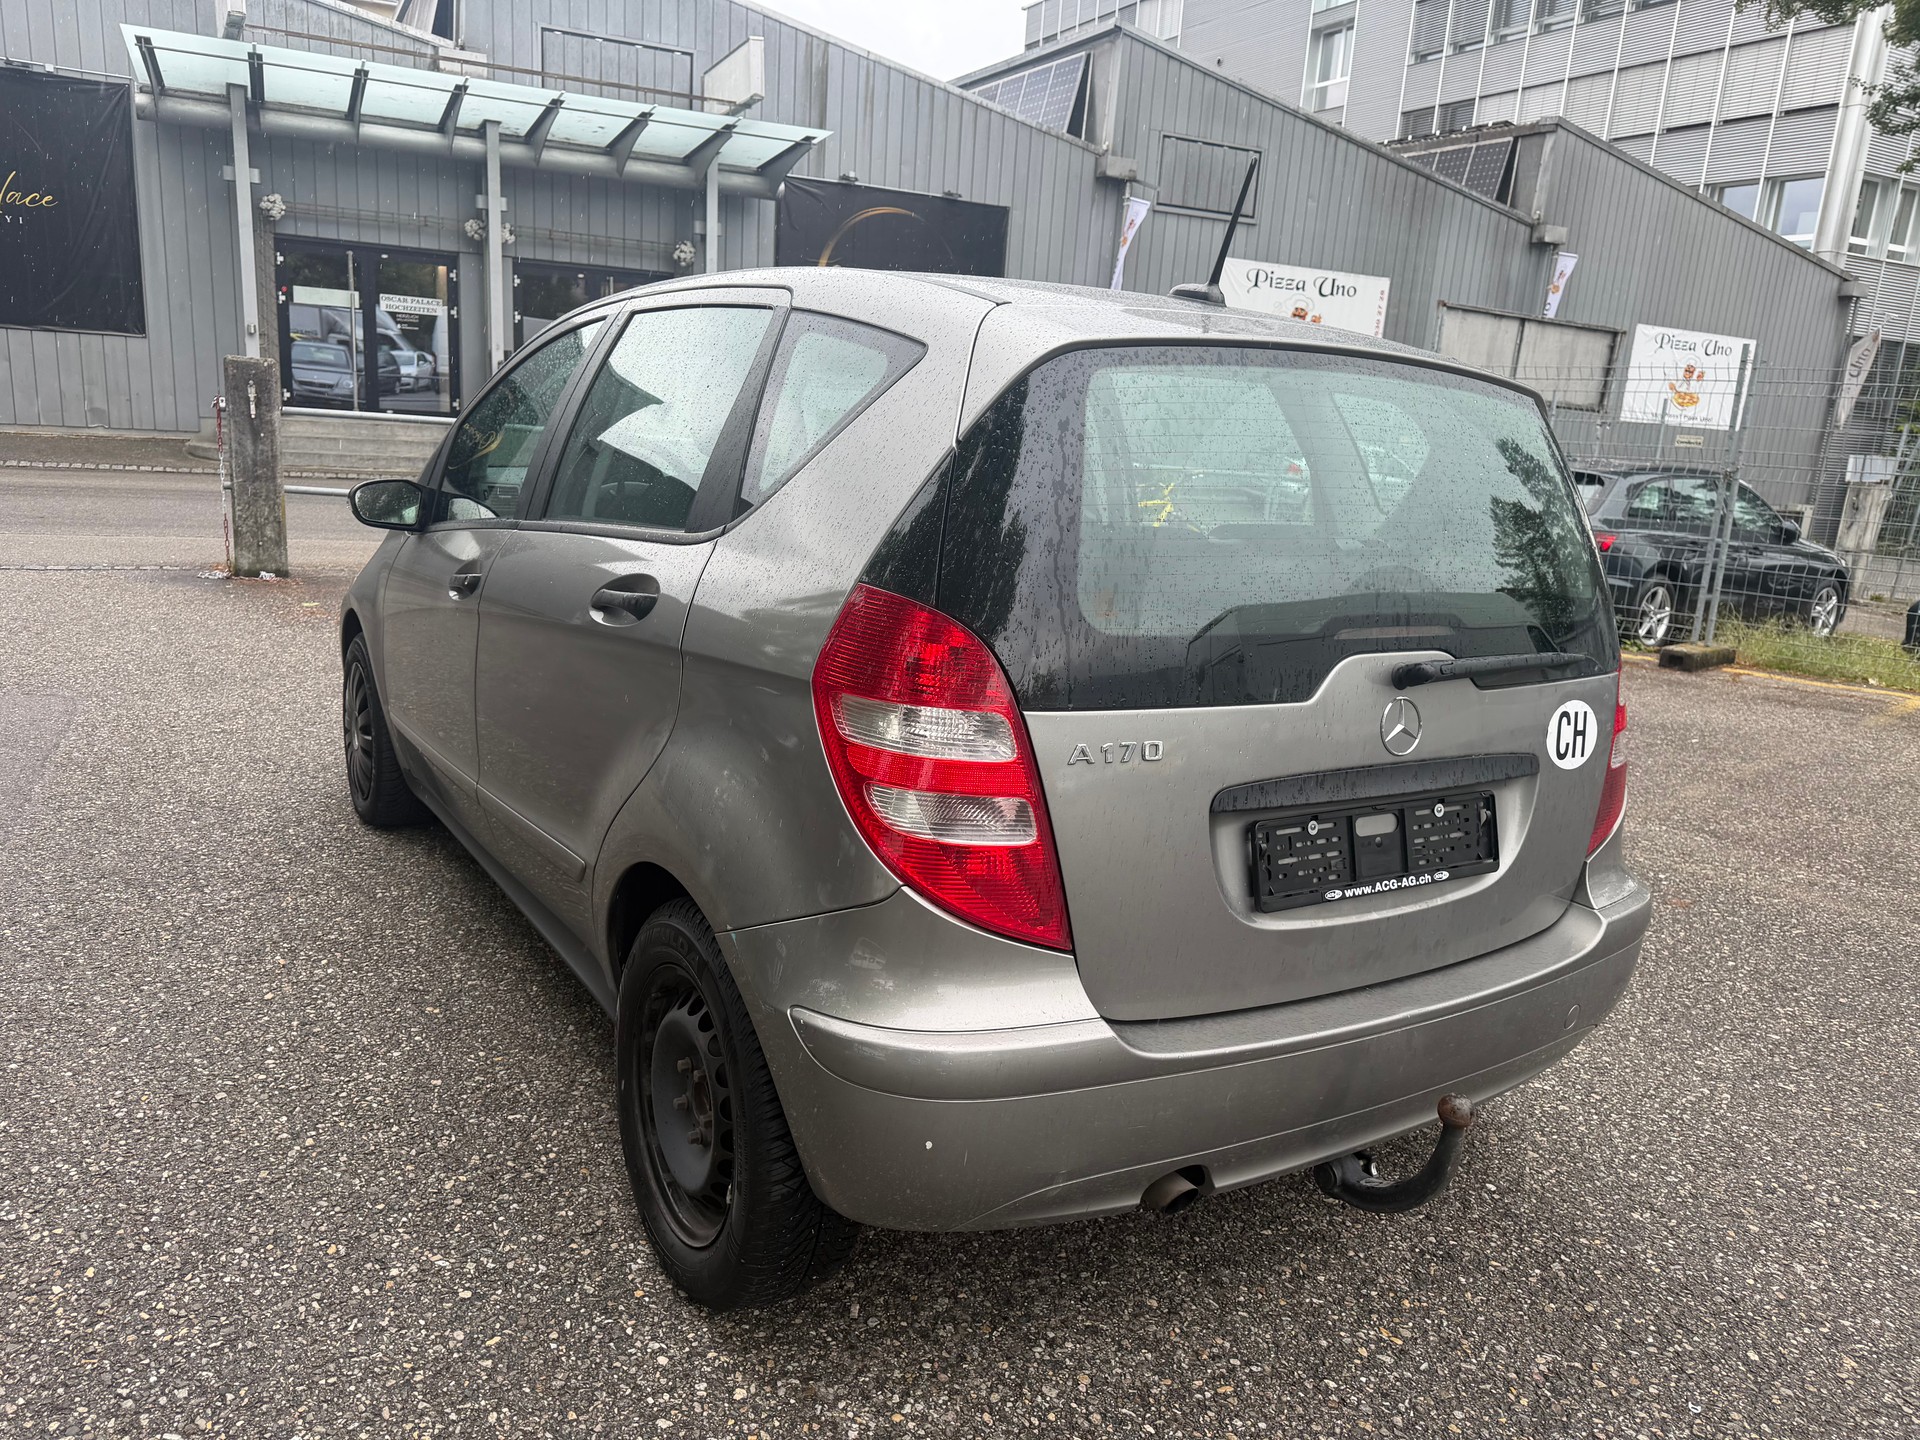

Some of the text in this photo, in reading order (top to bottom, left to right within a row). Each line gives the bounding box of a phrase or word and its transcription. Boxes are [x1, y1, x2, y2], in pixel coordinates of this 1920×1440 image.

[1246, 268, 1357, 298] Pizza Uno
[385, 304, 438, 313] HOCHZEITEN
[1654, 333, 1733, 357] Pizza Uno
[1556, 710, 1587, 760] CH
[1344, 873, 1432, 897] www.ACG-AG.ch
